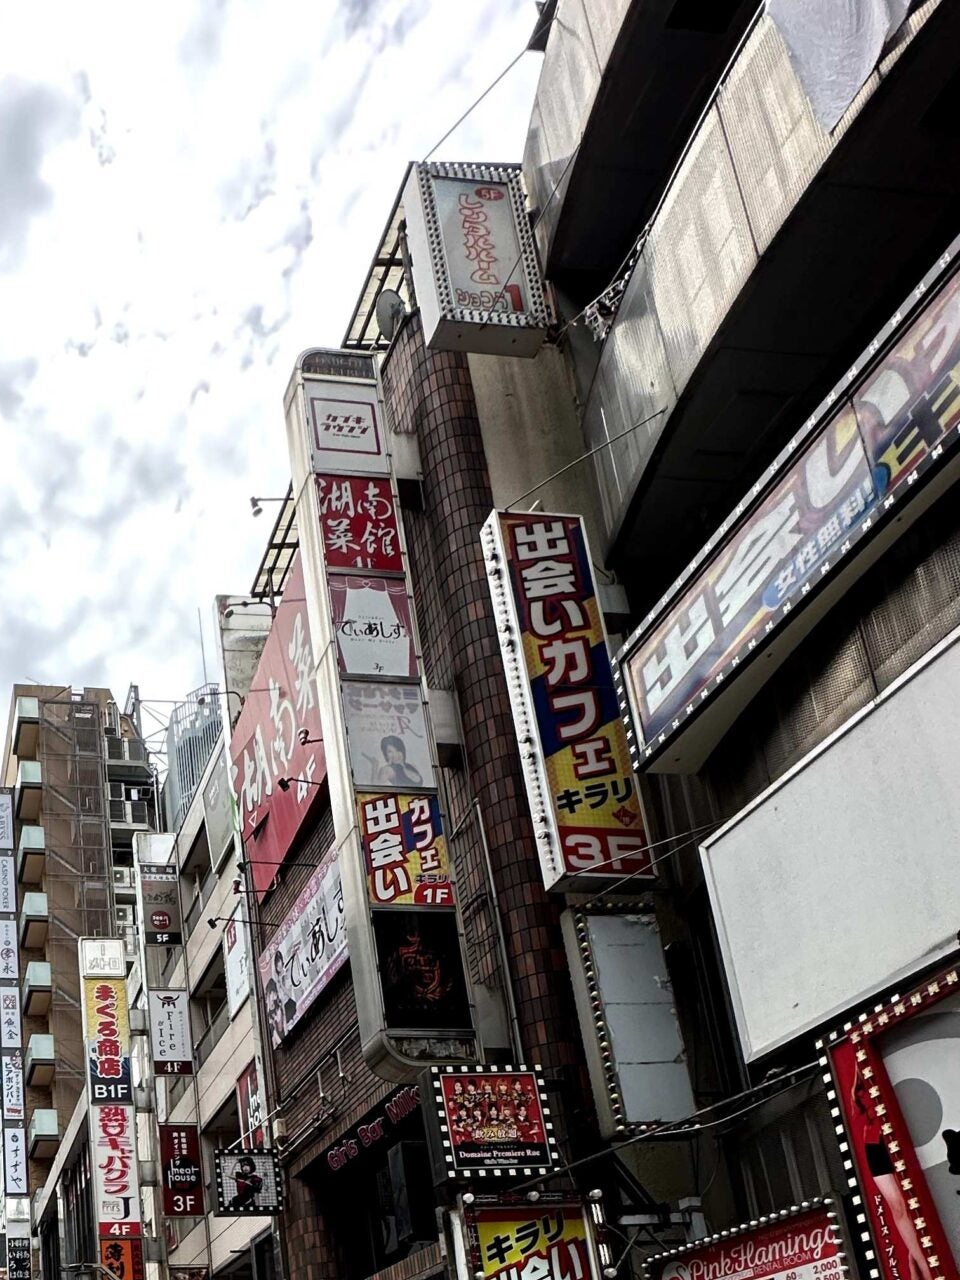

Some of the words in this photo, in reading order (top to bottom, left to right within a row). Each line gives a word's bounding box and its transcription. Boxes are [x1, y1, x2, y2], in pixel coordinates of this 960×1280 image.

[318, 481, 392, 520] 湖南
[326, 519, 397, 557] 菜館
[514, 520, 615, 780] 出会いカフェ
[556, 776, 635, 814] キラリ
[364, 797, 410, 901] 出会い
[410, 798, 441, 873] カフェ
[565, 834, 644, 872] 3F
[423, 888, 449, 903] 1F
[95, 983, 123, 1079] まぐろ商店
[158, 1029, 167, 1058] Ice
[167, 1011, 177, 1052] Fire
[164, 1062, 183, 1073] 4F
[94, 1084, 129, 1099] B1F
[10, 1144, 23, 1189] すずや
[168, 1170, 197, 1190] house
[172, 1195, 196, 1212] 3F
[109, 1223, 131, 1236] 4F
[486, 1210, 565, 1265] キラリ
[753, 1261, 783, 1276] RENTAL
[783, 1251, 813, 1269] ROOM
[812, 1260, 838, 1275] 2,000
